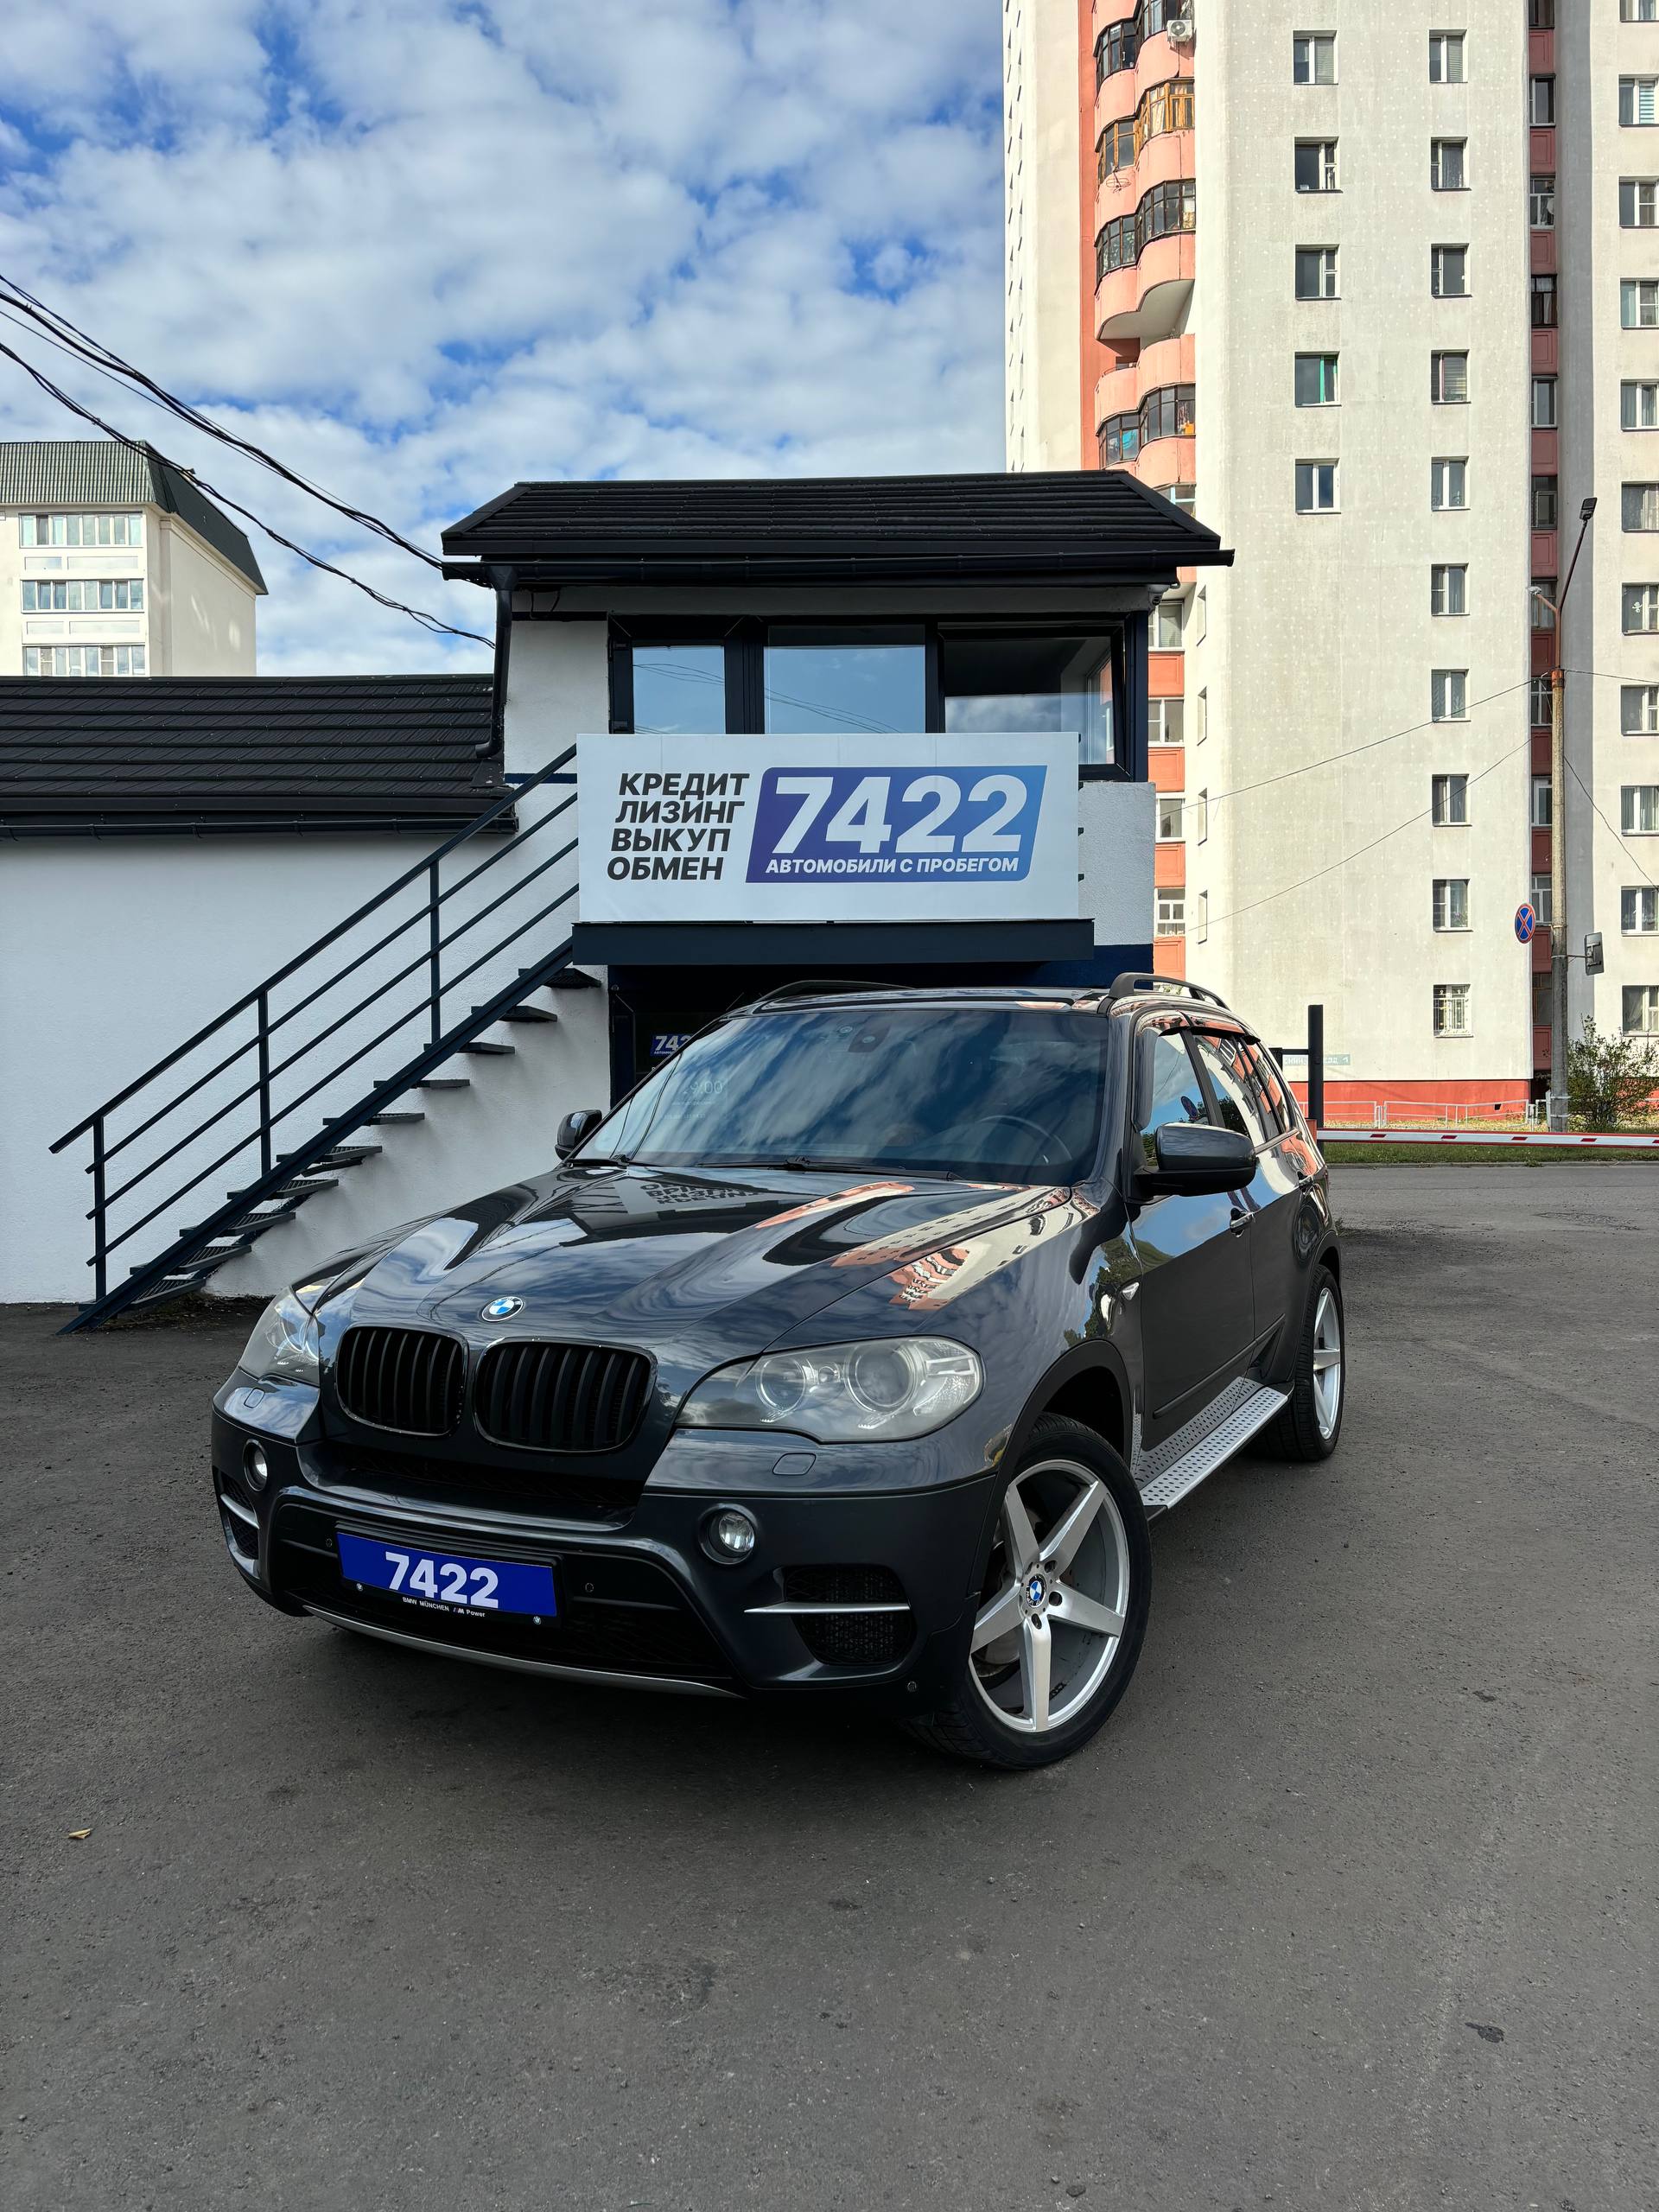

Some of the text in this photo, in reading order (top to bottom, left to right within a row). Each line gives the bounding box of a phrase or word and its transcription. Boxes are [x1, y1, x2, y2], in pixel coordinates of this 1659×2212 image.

[619, 772, 750, 800] КРЕДИТ
[614, 800, 746, 823] ЛИЗИНГ
[771, 774, 1028, 855] 7422
[610, 828, 731, 852] ВЫКУП
[607, 856, 724, 880] ОБМЕН
[765, 856, 1019, 874] АВТОМОБИЛИ С ПРОБЕГОМ
[655, 1035, 691, 1052] 74
[385, 1551, 499, 1609] 7422
[419, 1600, 449, 1611] MÜNCHEN
[467, 1609, 486, 1618] Power
